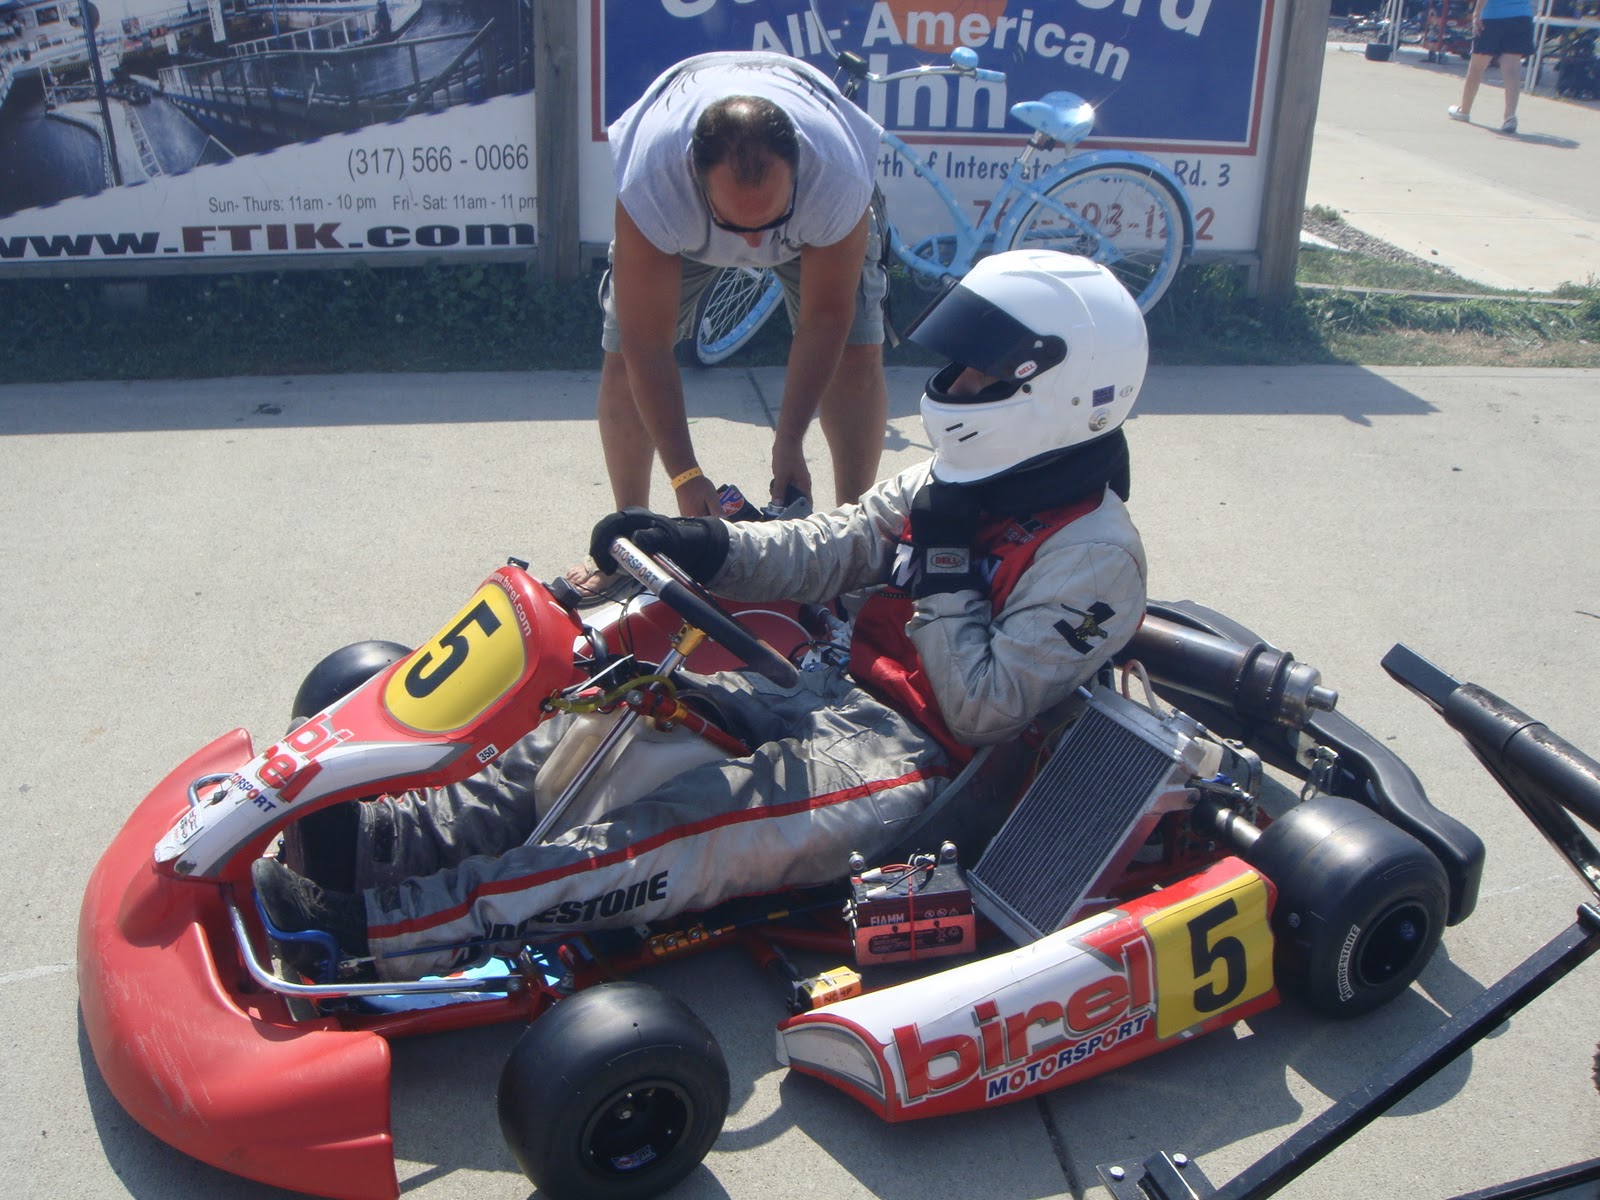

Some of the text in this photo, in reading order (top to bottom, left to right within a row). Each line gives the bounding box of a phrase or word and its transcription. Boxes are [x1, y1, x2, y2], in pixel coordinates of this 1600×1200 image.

[867, 54, 1008, 129] Inn
[348, 147, 404, 181] (317)
[412, 146, 451, 172] 566
[475, 144, 529, 170] 0066
[1174, 160, 1207, 187] Rd.
[1218, 163, 1231, 187] 3
[243, 196, 284, 213] Thurs:
[289, 195, 323, 212] 11am
[337, 195, 352, 210] 10
[357, 198, 376, 213] pm
[453, 194, 487, 210] 11am
[500, 193, 514, 209] 11
[613, 543, 659, 585] OTORSPORT
[935, 554, 960, 566] BELL
[405, 599, 501, 698] 5
[478, 746, 497, 762] 350
[870, 913, 905, 926] FIAMM
[1186, 897, 1248, 1013] 5
[893, 936, 1157, 1107] birel
[987, 1014, 1149, 1100] MOTORSPORT
